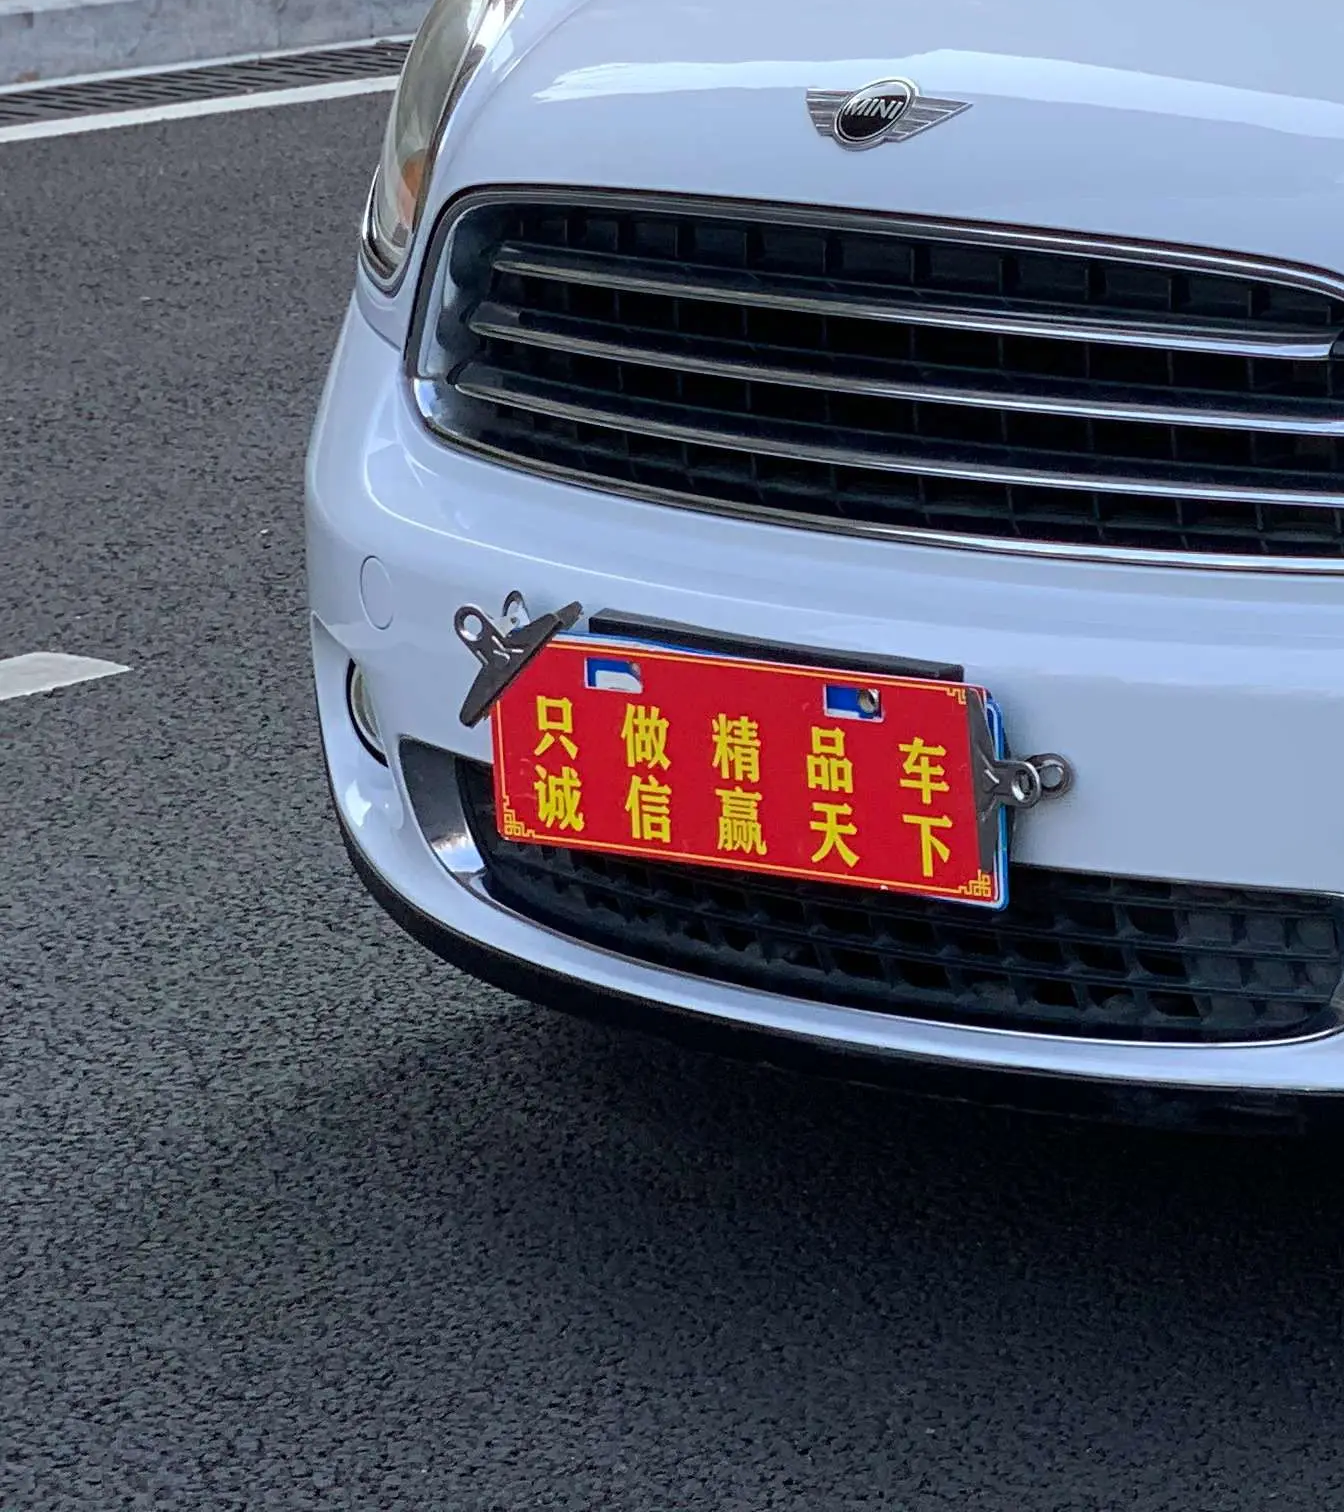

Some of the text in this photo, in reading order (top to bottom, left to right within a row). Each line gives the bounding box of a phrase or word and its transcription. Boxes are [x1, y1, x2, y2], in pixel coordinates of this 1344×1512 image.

[844, 98, 904, 120] MINI
[534, 695, 951, 805] 只做精品车
[534, 766, 954, 878] 诚信赢天下
